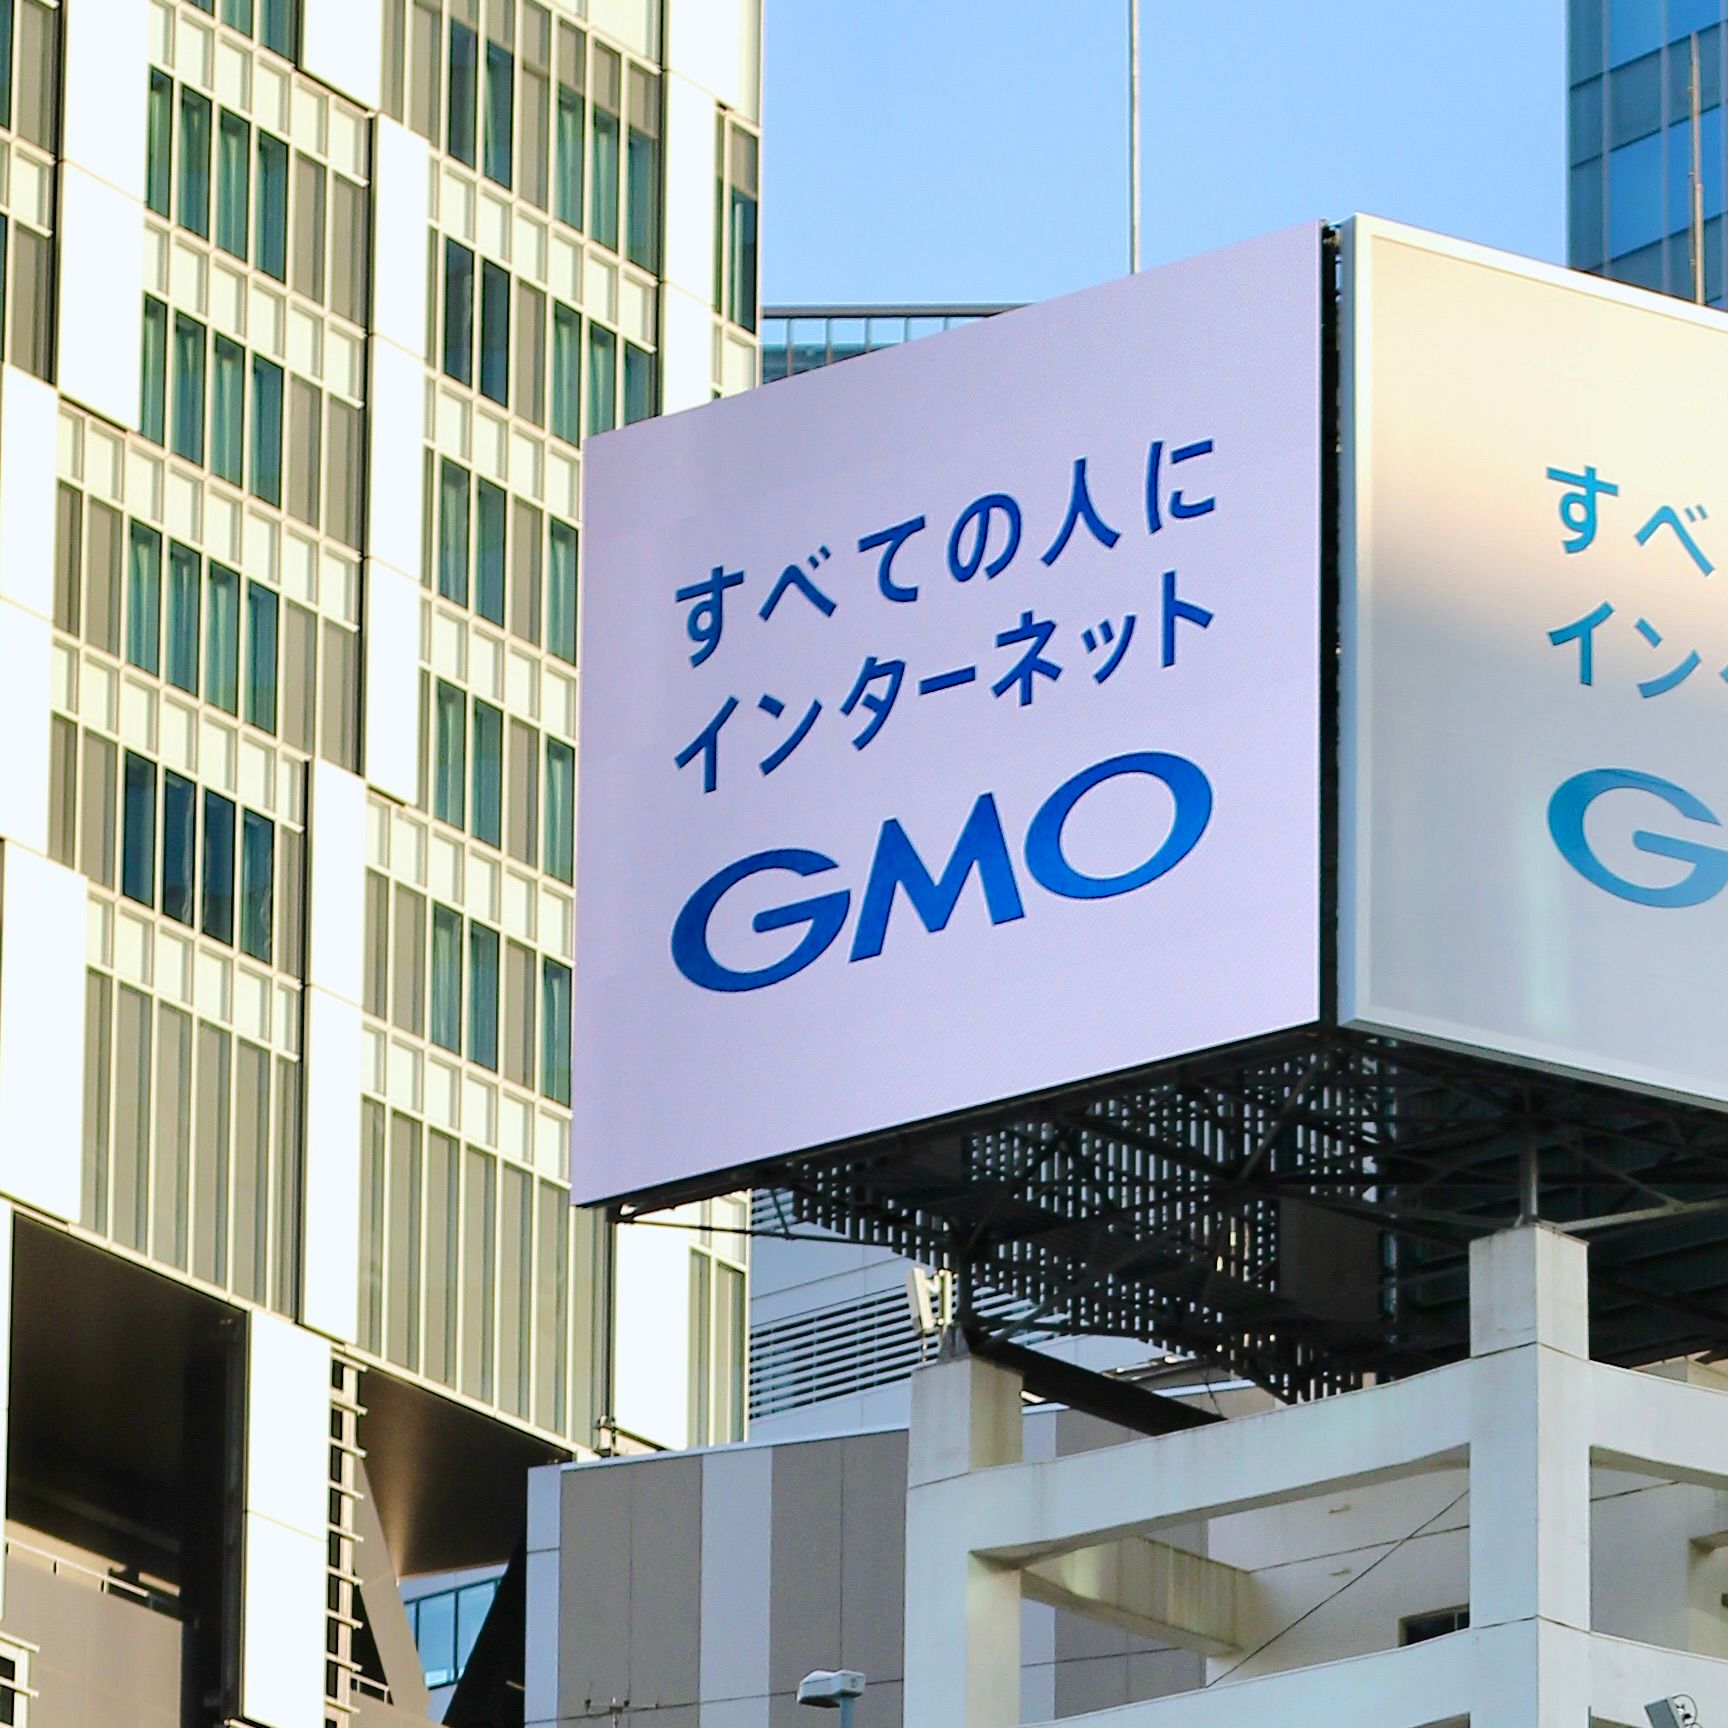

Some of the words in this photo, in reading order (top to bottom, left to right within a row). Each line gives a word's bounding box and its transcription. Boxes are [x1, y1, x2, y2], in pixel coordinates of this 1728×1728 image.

[675, 438, 1215, 668] すべての人に
[673, 569, 1215, 794] インターネット
[671, 750, 1214, 994] GMO
